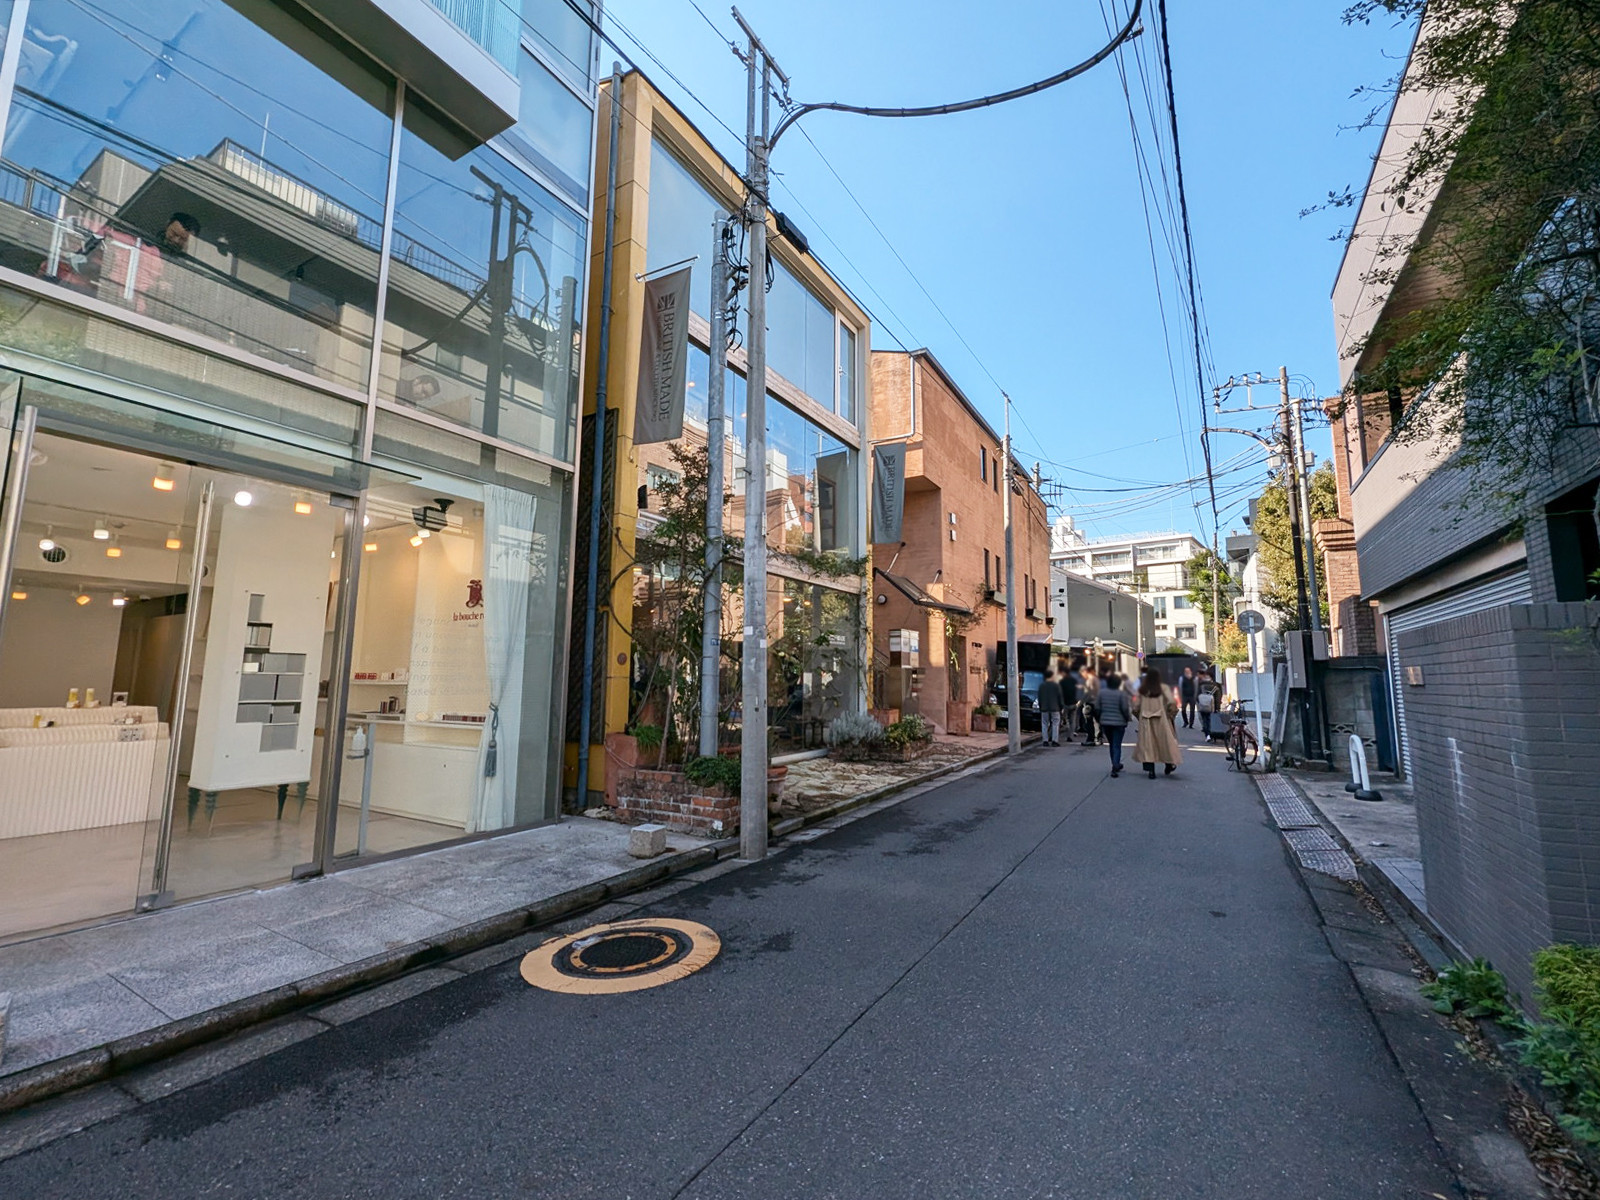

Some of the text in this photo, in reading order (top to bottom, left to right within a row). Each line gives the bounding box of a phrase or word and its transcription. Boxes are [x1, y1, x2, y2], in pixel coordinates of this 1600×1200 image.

[658, 313, 674, 422] BRITISH MADE
[885, 465, 895, 502] BRITISH
[459, 611, 479, 620] bouche
